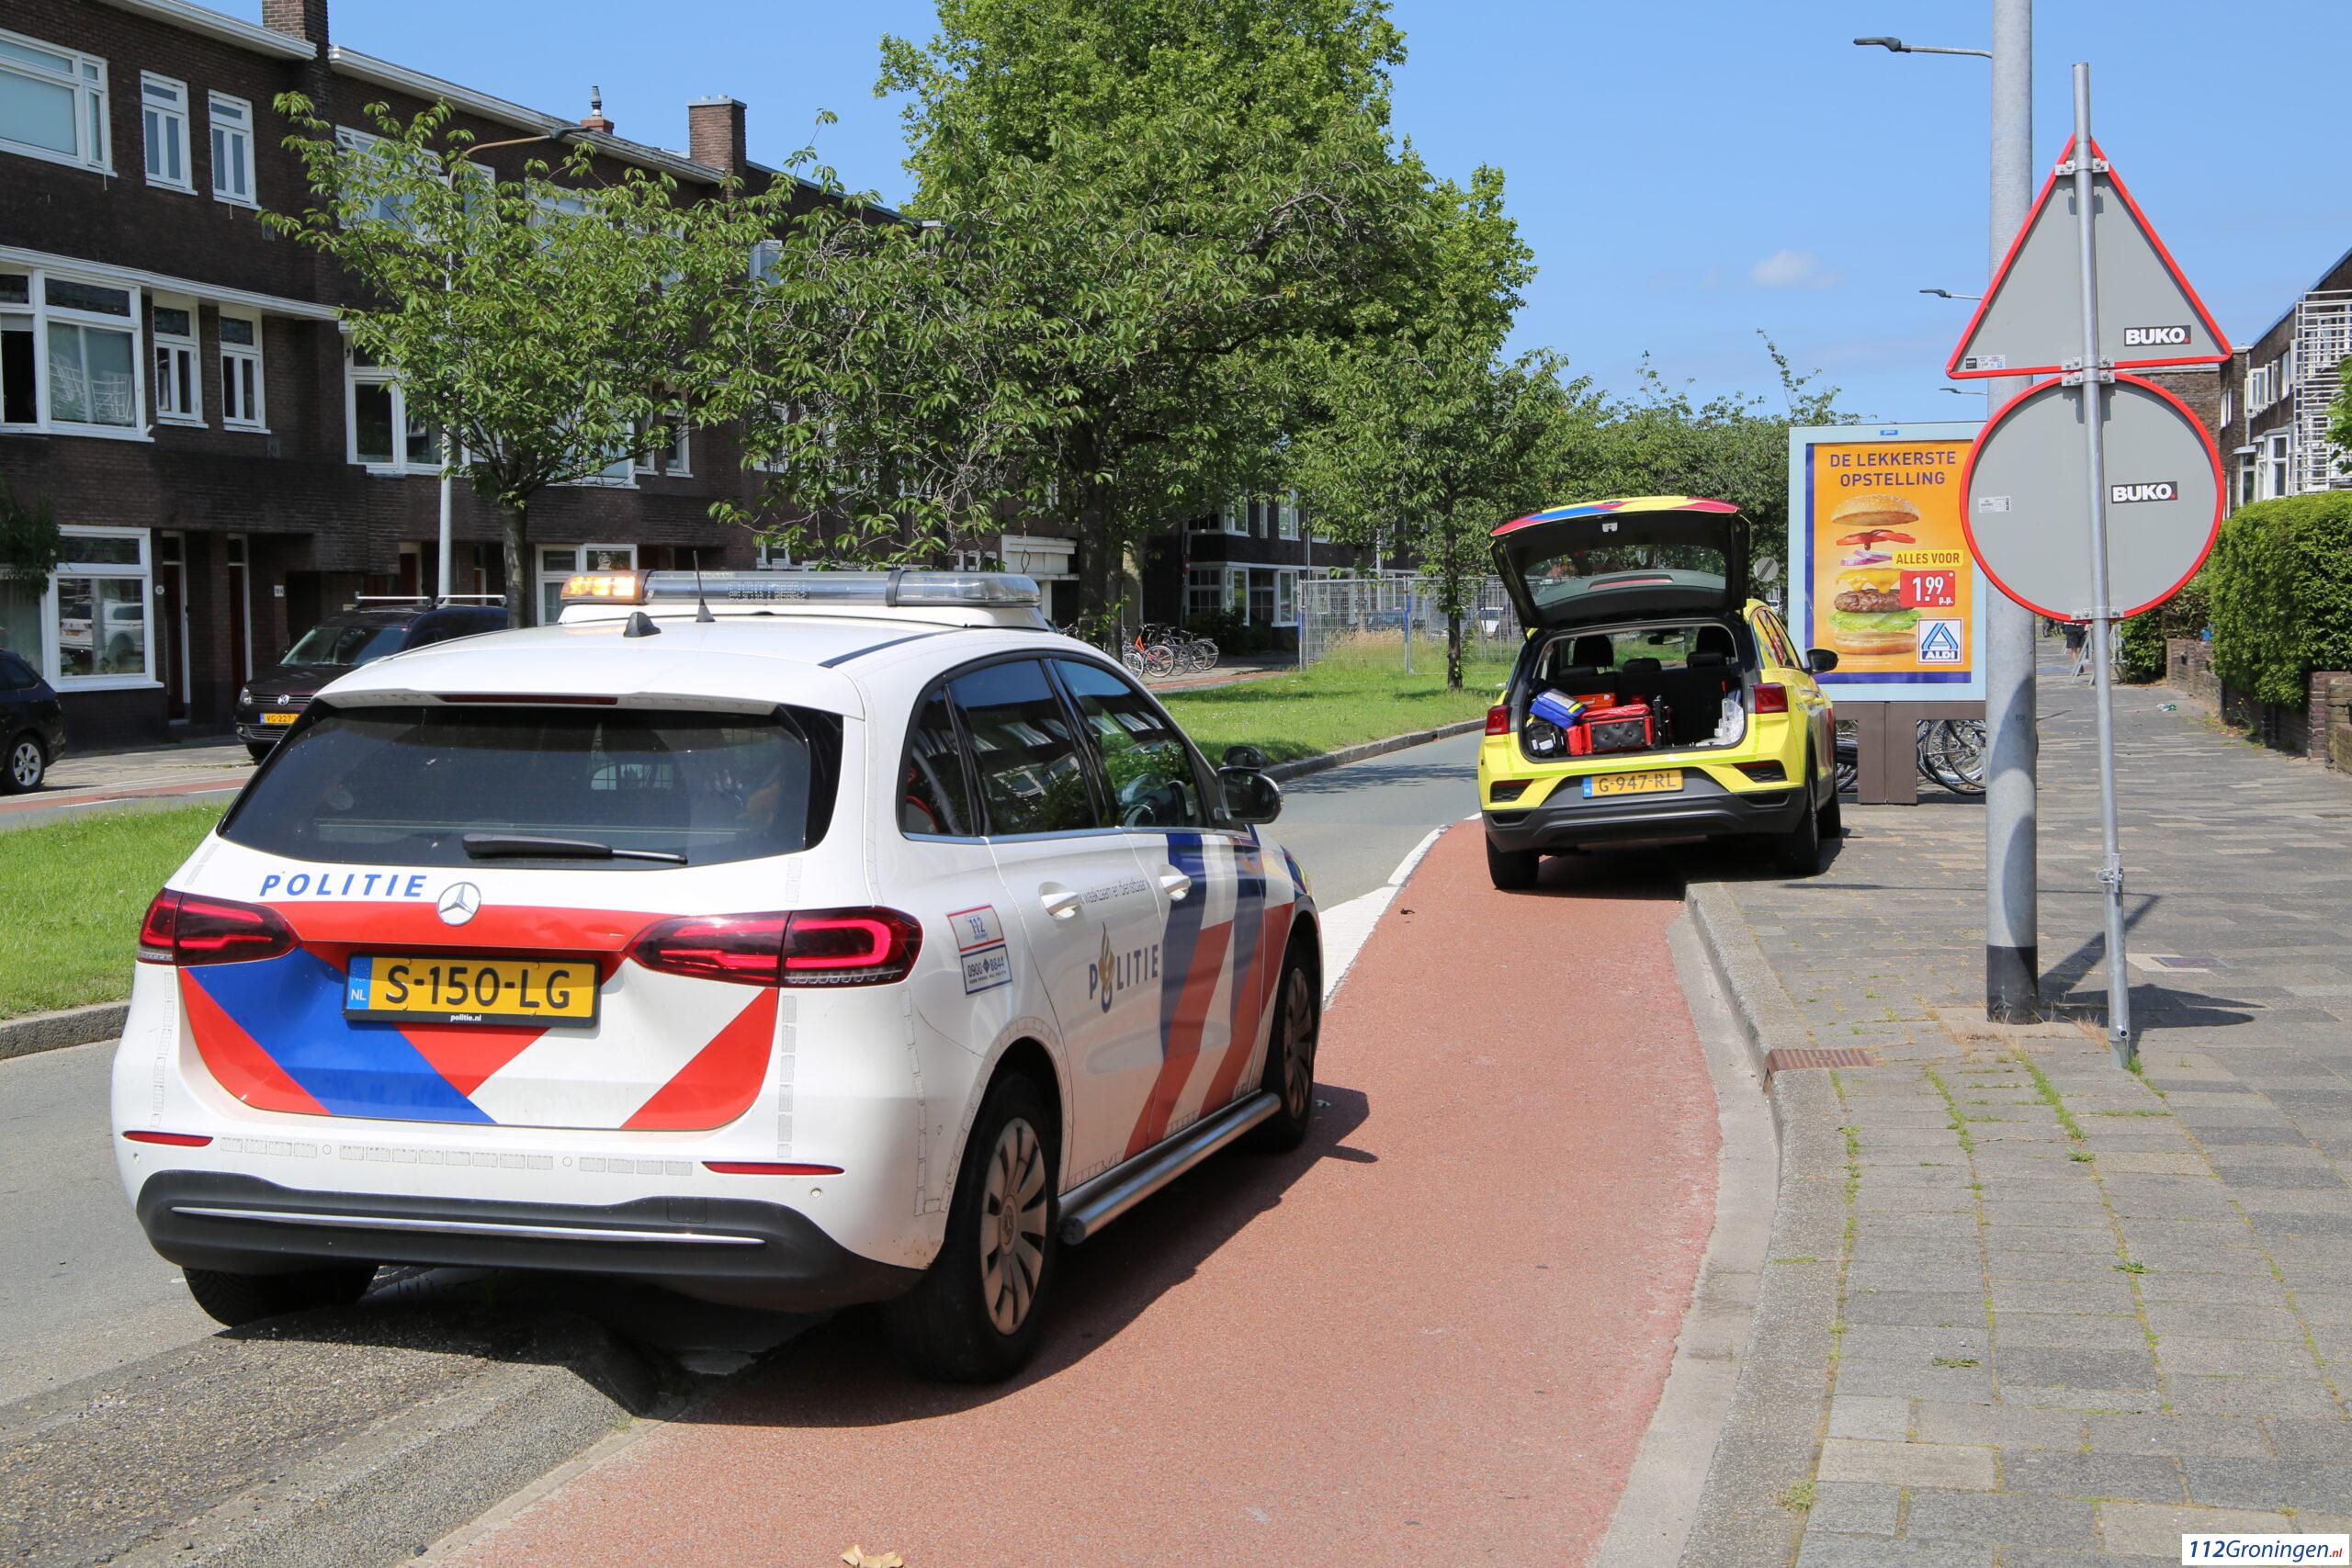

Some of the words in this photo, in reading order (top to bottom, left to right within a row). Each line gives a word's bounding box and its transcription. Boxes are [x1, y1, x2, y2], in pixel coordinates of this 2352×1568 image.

[1830, 454, 1851, 467] DE
[1857, 451, 1956, 467] LEKKERSTE
[1840, 471, 1945, 487] OPSTELLING
[1896, 554, 1928, 564] ALLES
[1931, 553, 1960, 563] VOOR
[1925, 650, 1955, 660] ALDI
[1599, 773, 1677, 793] G-947-RL
[259, 874, 427, 897] POLITIE
[969, 916, 986, 934] 112
[350, 988, 367, 1001] NL
[386, 964, 571, 1010] S-150-LG
[450, 1013, 481, 1022] politie.nl
